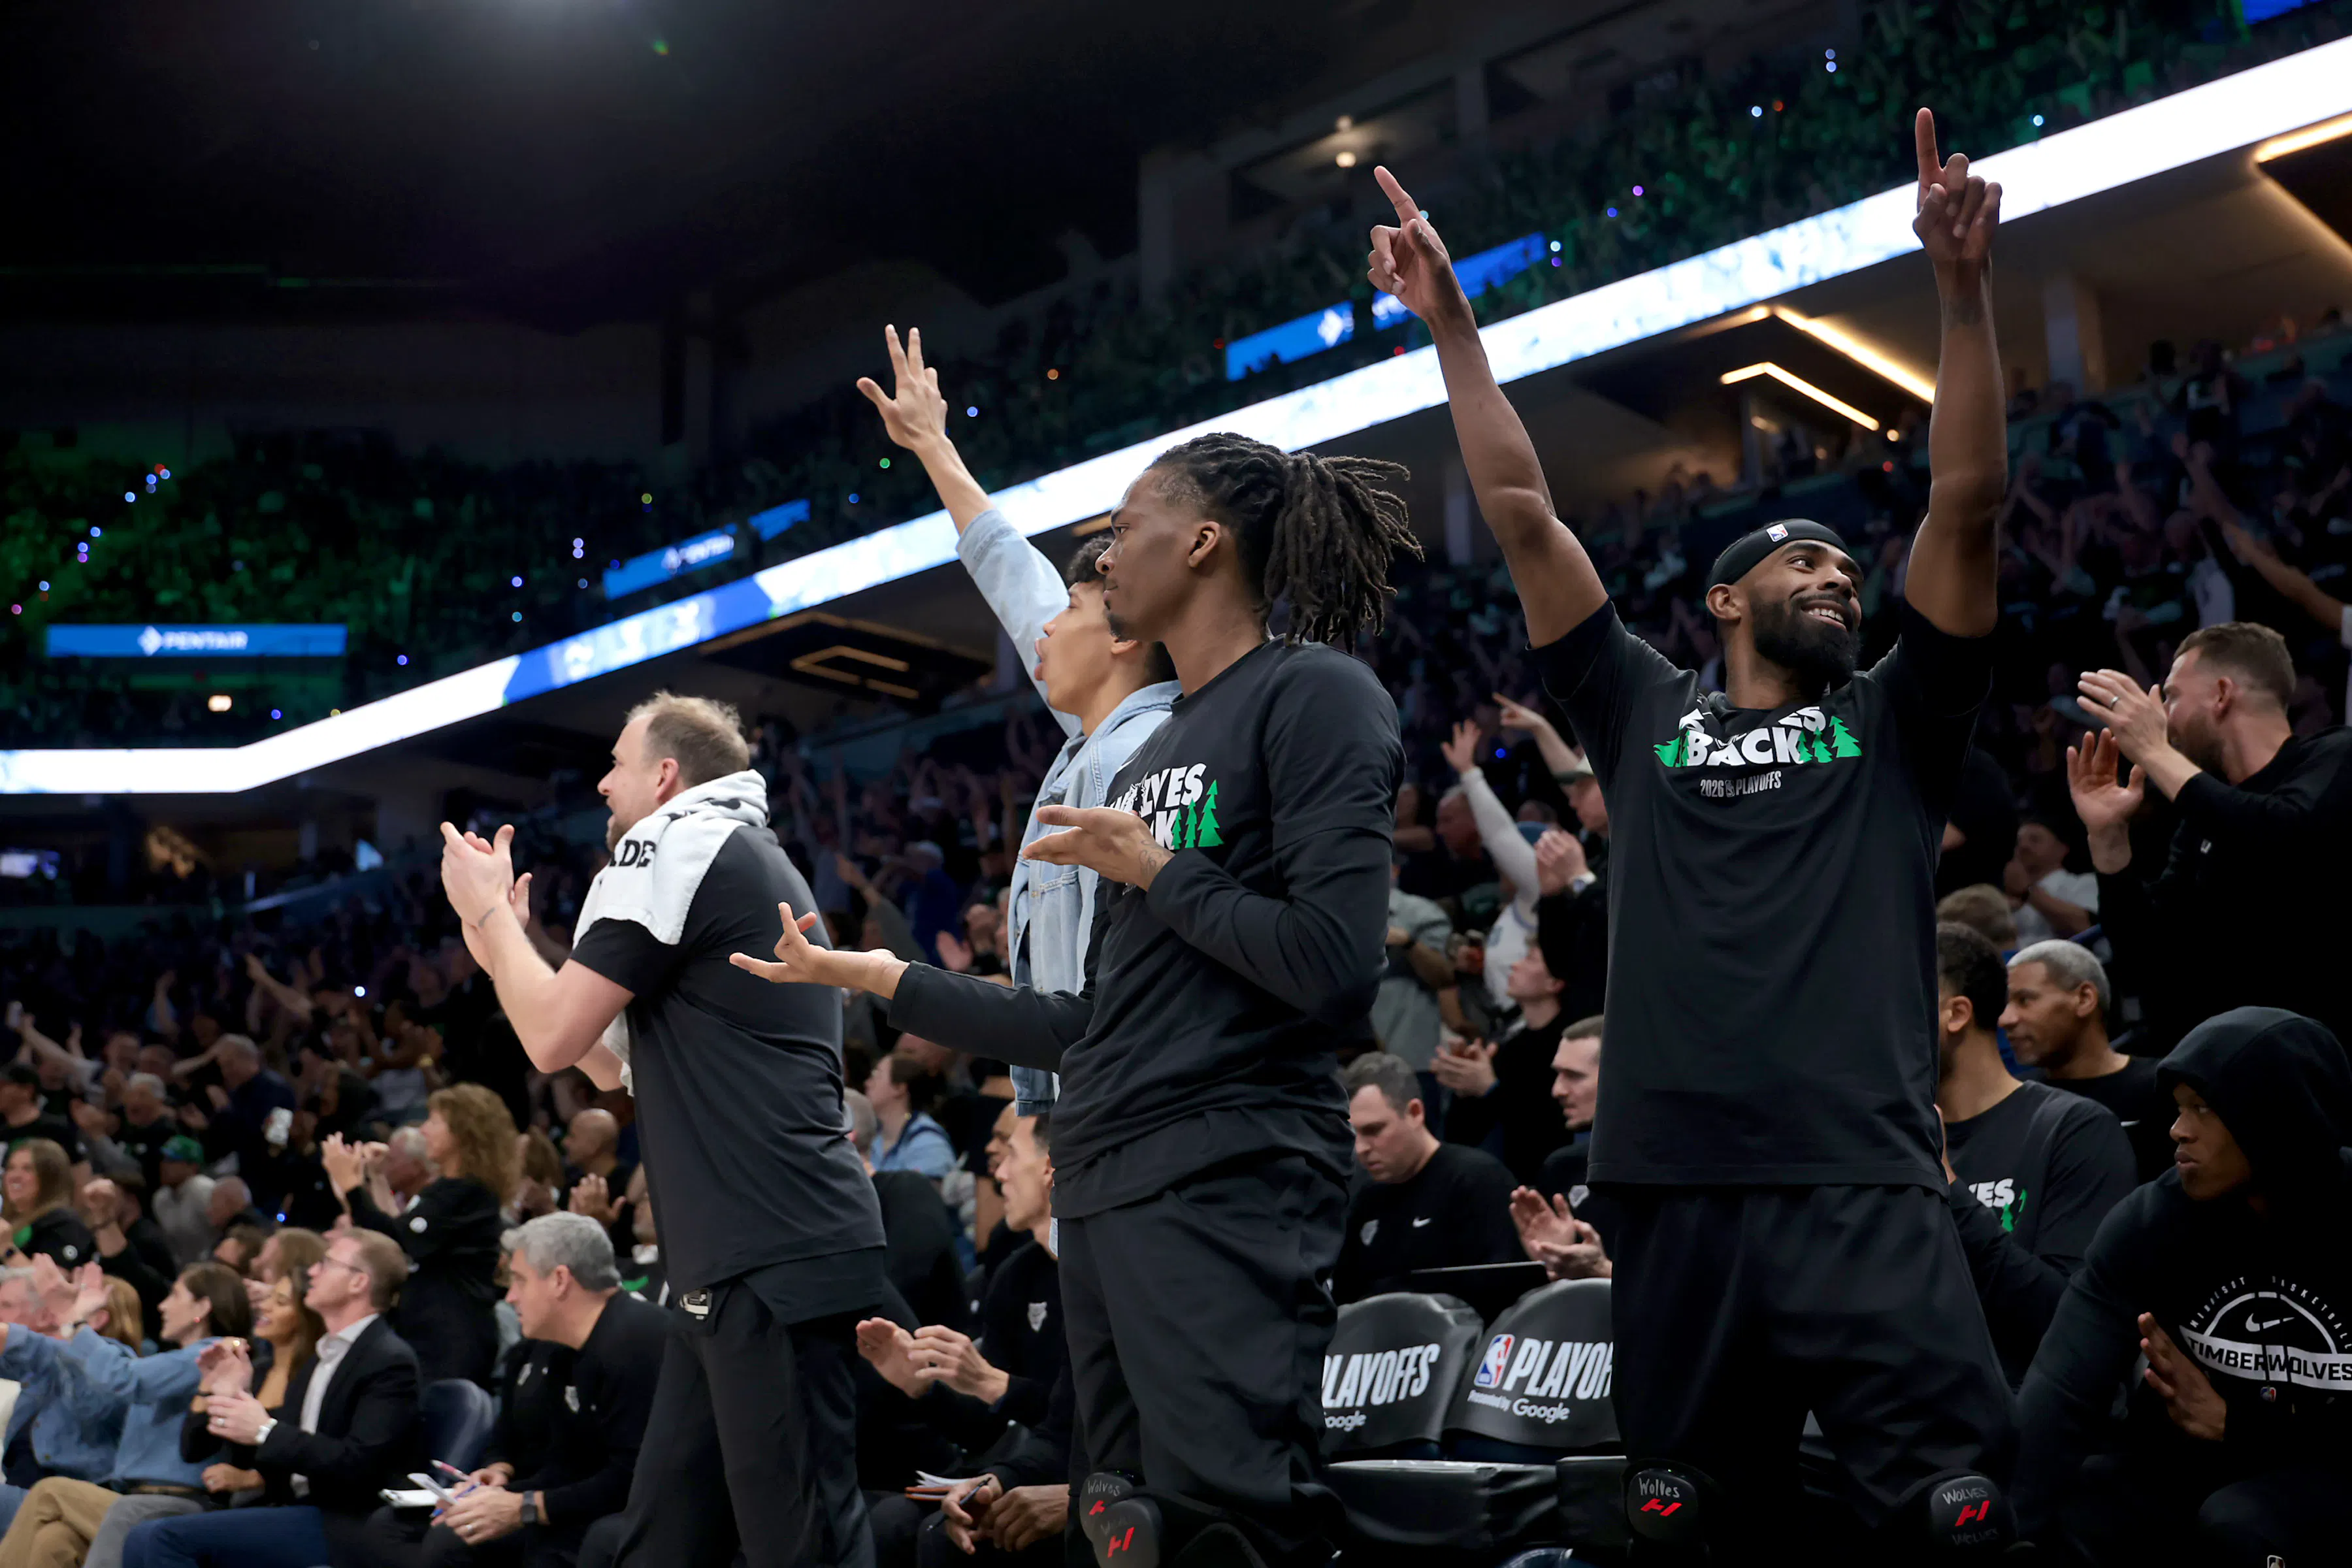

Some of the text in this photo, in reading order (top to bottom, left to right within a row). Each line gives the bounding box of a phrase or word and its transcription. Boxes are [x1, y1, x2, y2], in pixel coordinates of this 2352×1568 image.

[1688, 727, 1805, 766] BACK
[1700, 770, 1782, 798] 2026 PLAYOFFS
[1502, 1338, 1613, 1399] PLAYOF
[2187, 1336, 2352, 1380] TIMBERWOLVES
[1324, 1411, 1367, 1431] oogle
[1512, 1397, 1570, 1424] Google
